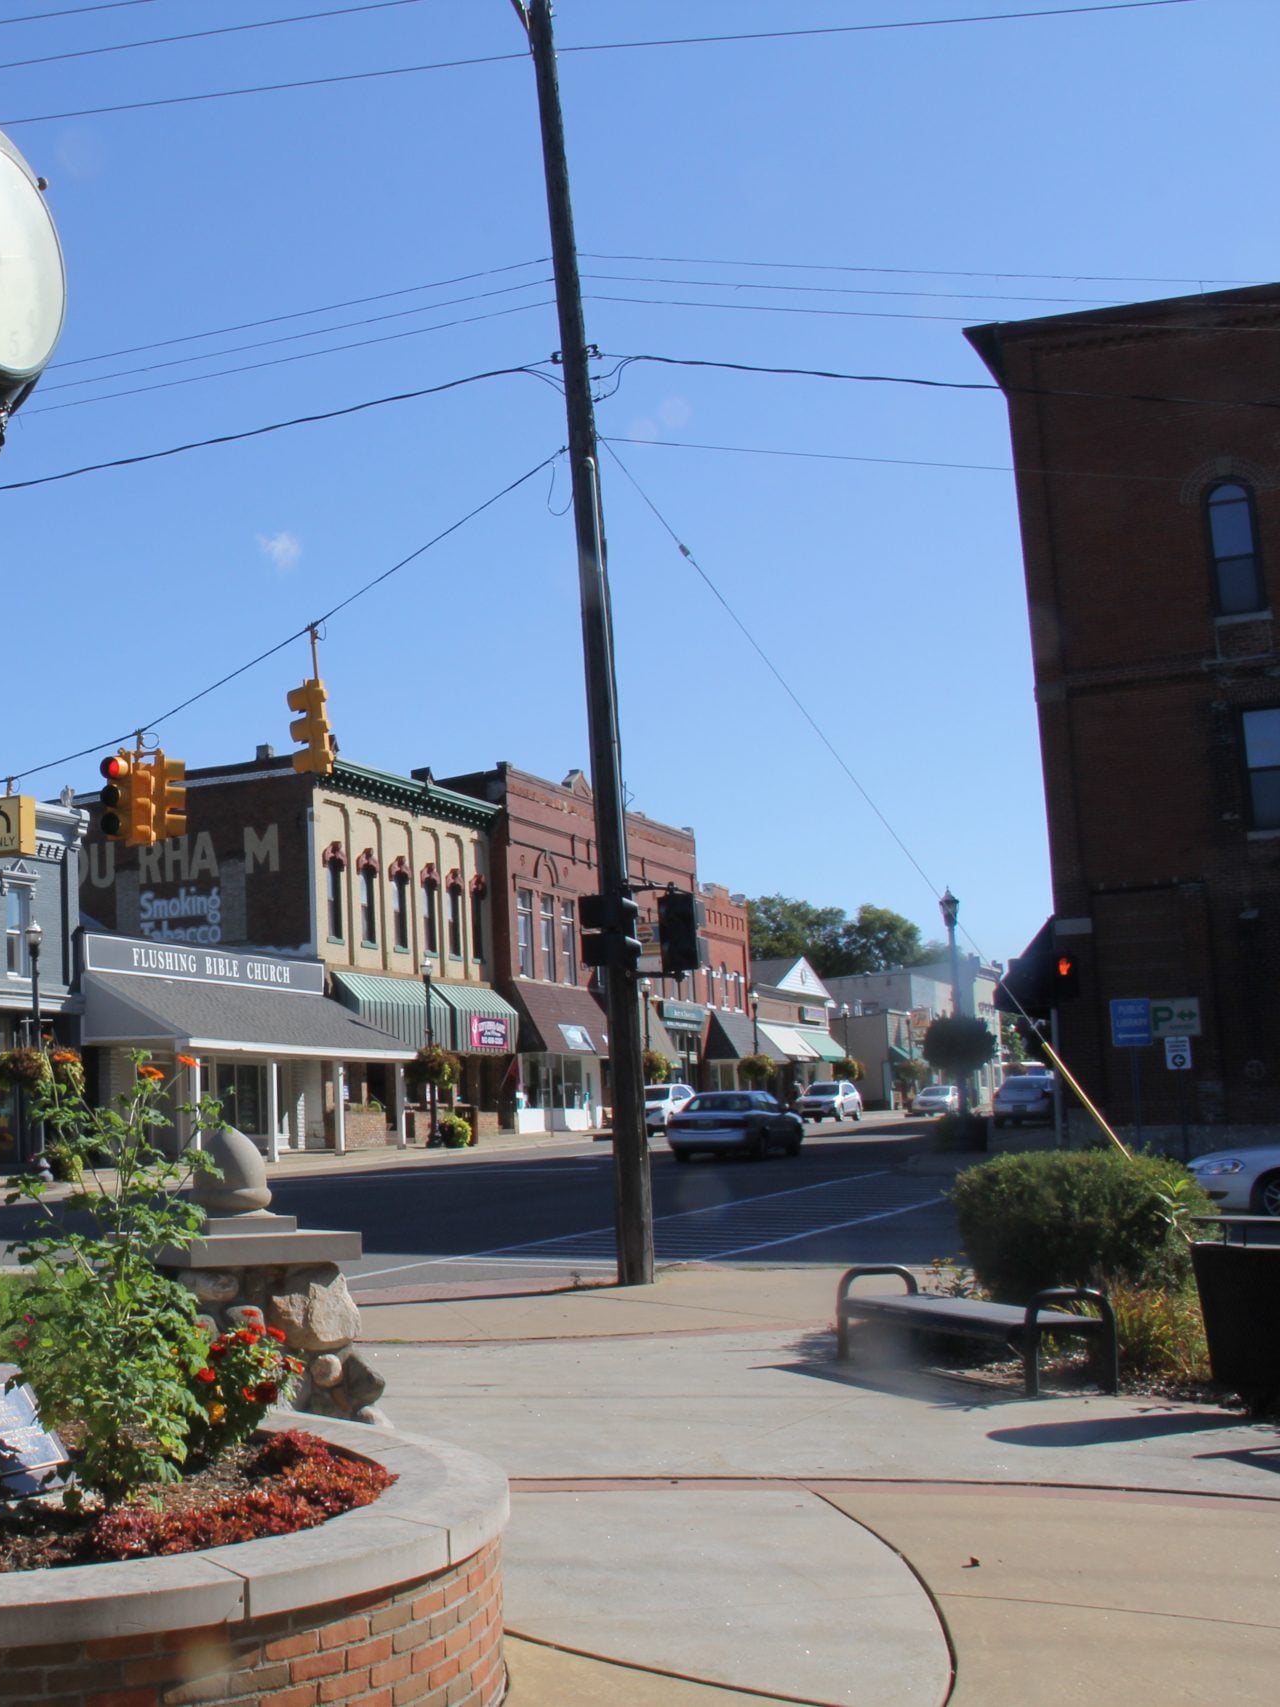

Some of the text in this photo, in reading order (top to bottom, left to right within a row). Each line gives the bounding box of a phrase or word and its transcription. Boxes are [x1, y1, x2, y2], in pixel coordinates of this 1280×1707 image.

[139, 886, 221, 925] Smoking
[131, 947, 291, 984] FLUSHING BIBLE CHURCH
[1152, 1006, 1175, 1031] P
